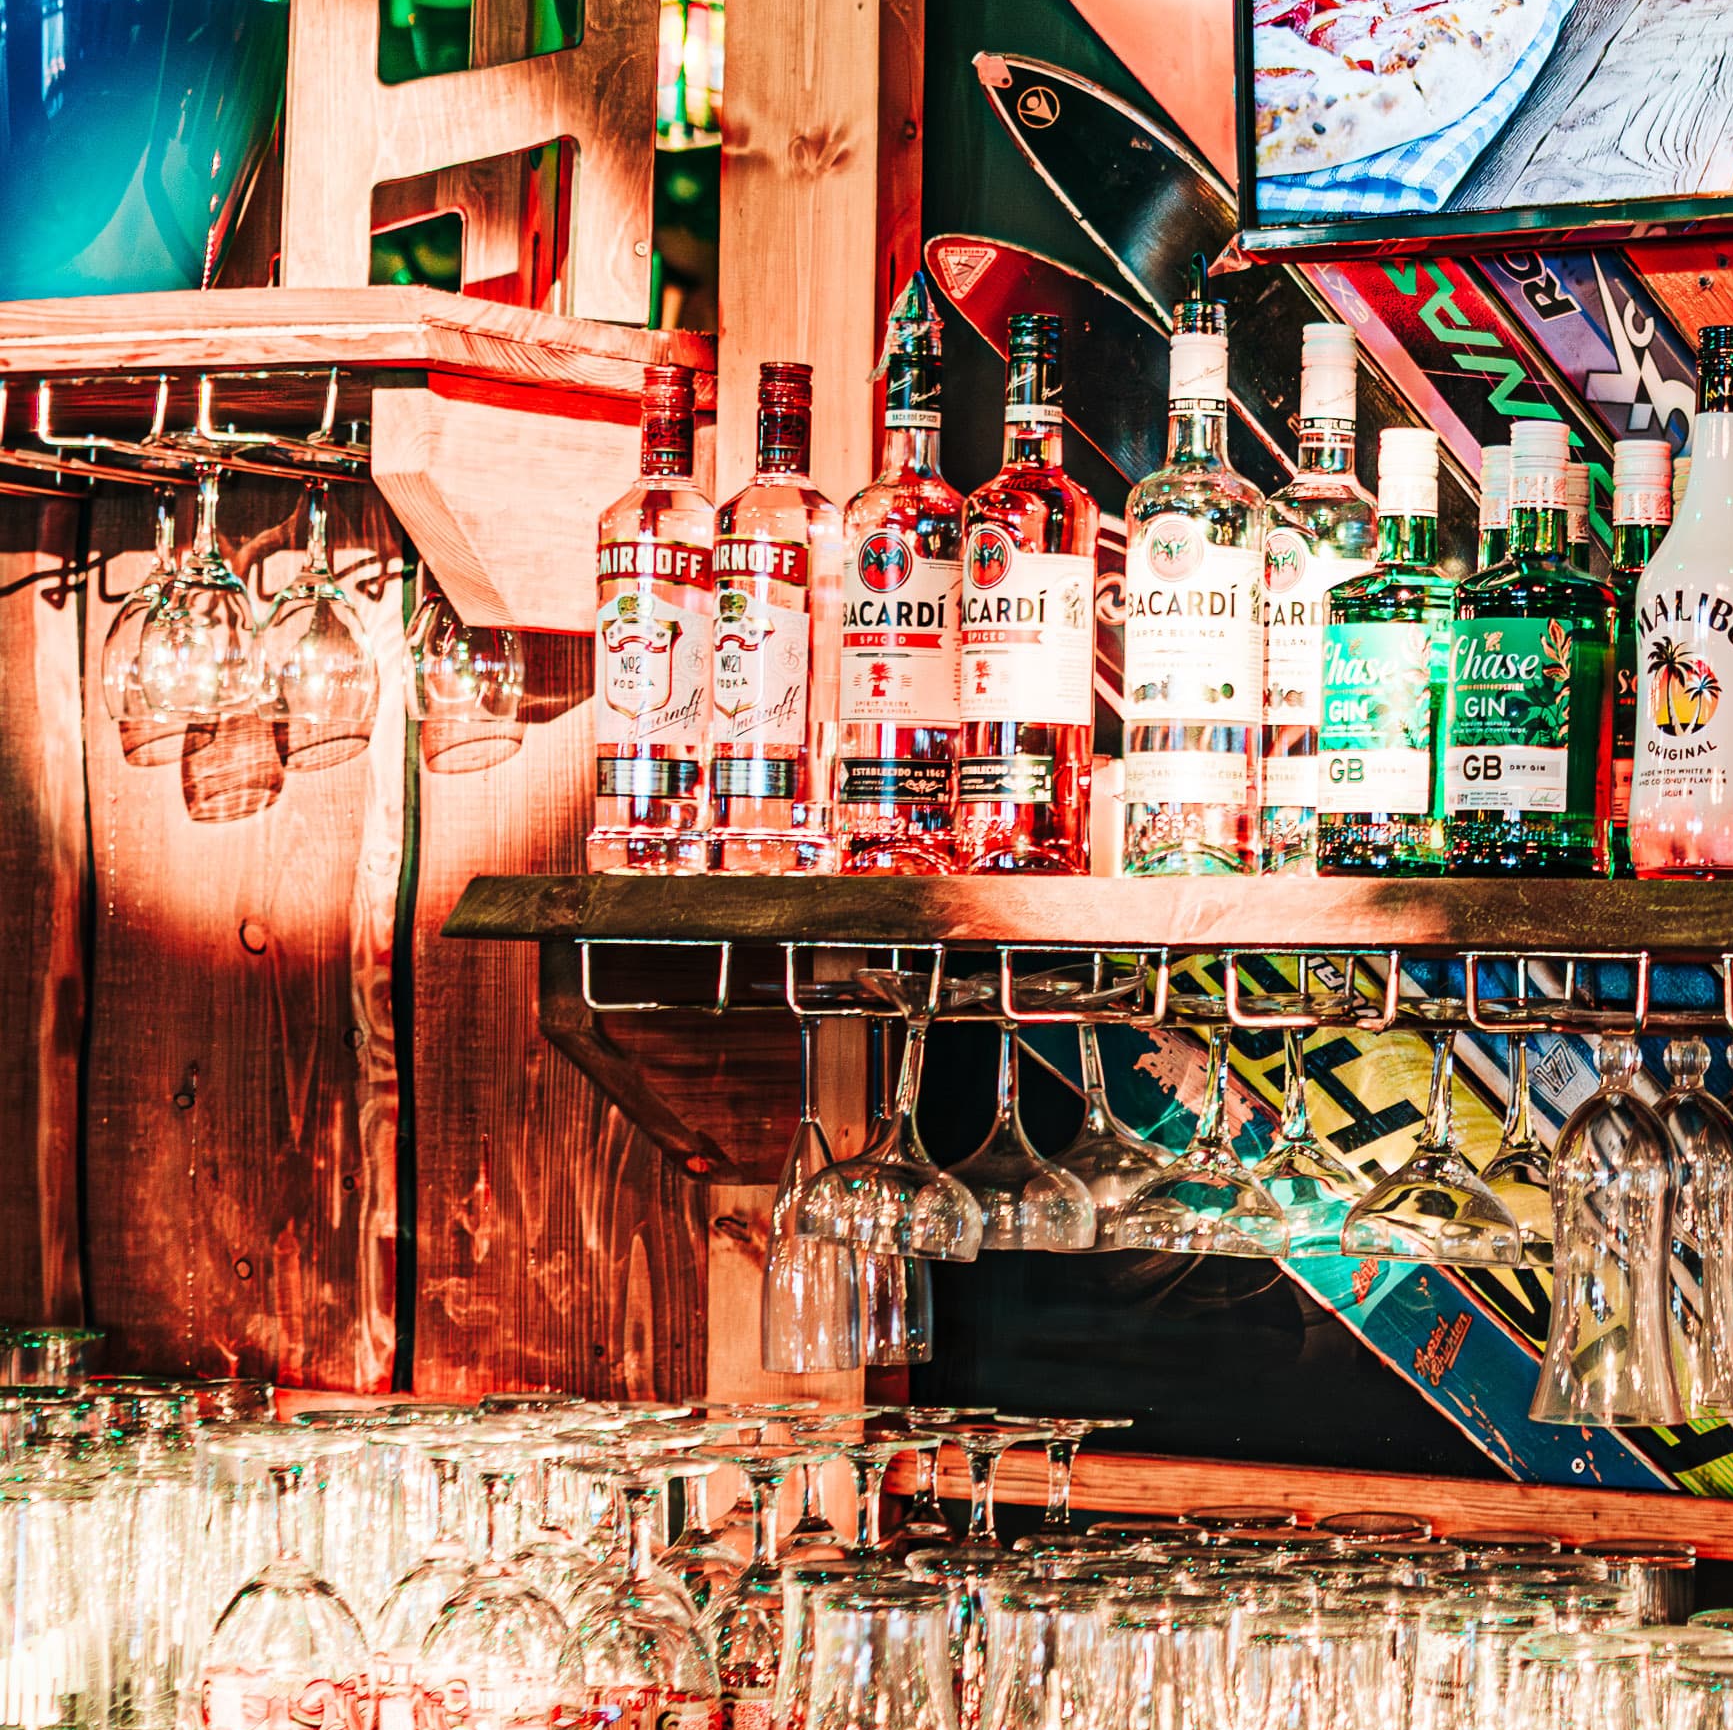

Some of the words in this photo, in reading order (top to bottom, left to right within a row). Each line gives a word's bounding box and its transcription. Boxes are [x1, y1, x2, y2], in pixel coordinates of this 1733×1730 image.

[600, 546, 703, 579] MIRNOFF
[713, 544, 796, 575] IRNOFF
[962, 590, 1047, 625] ACARDÍ
[1127, 584, 1238, 618] BACARDÍ
[859, 635, 907, 646] SPICD
[1451, 635, 1539, 681] Chase
[1329, 701, 1368, 722] GIN
[1464, 697, 1505, 717] GIN
[1330, 759, 1364, 783] GB
[1463, 755, 1502, 781] GB
